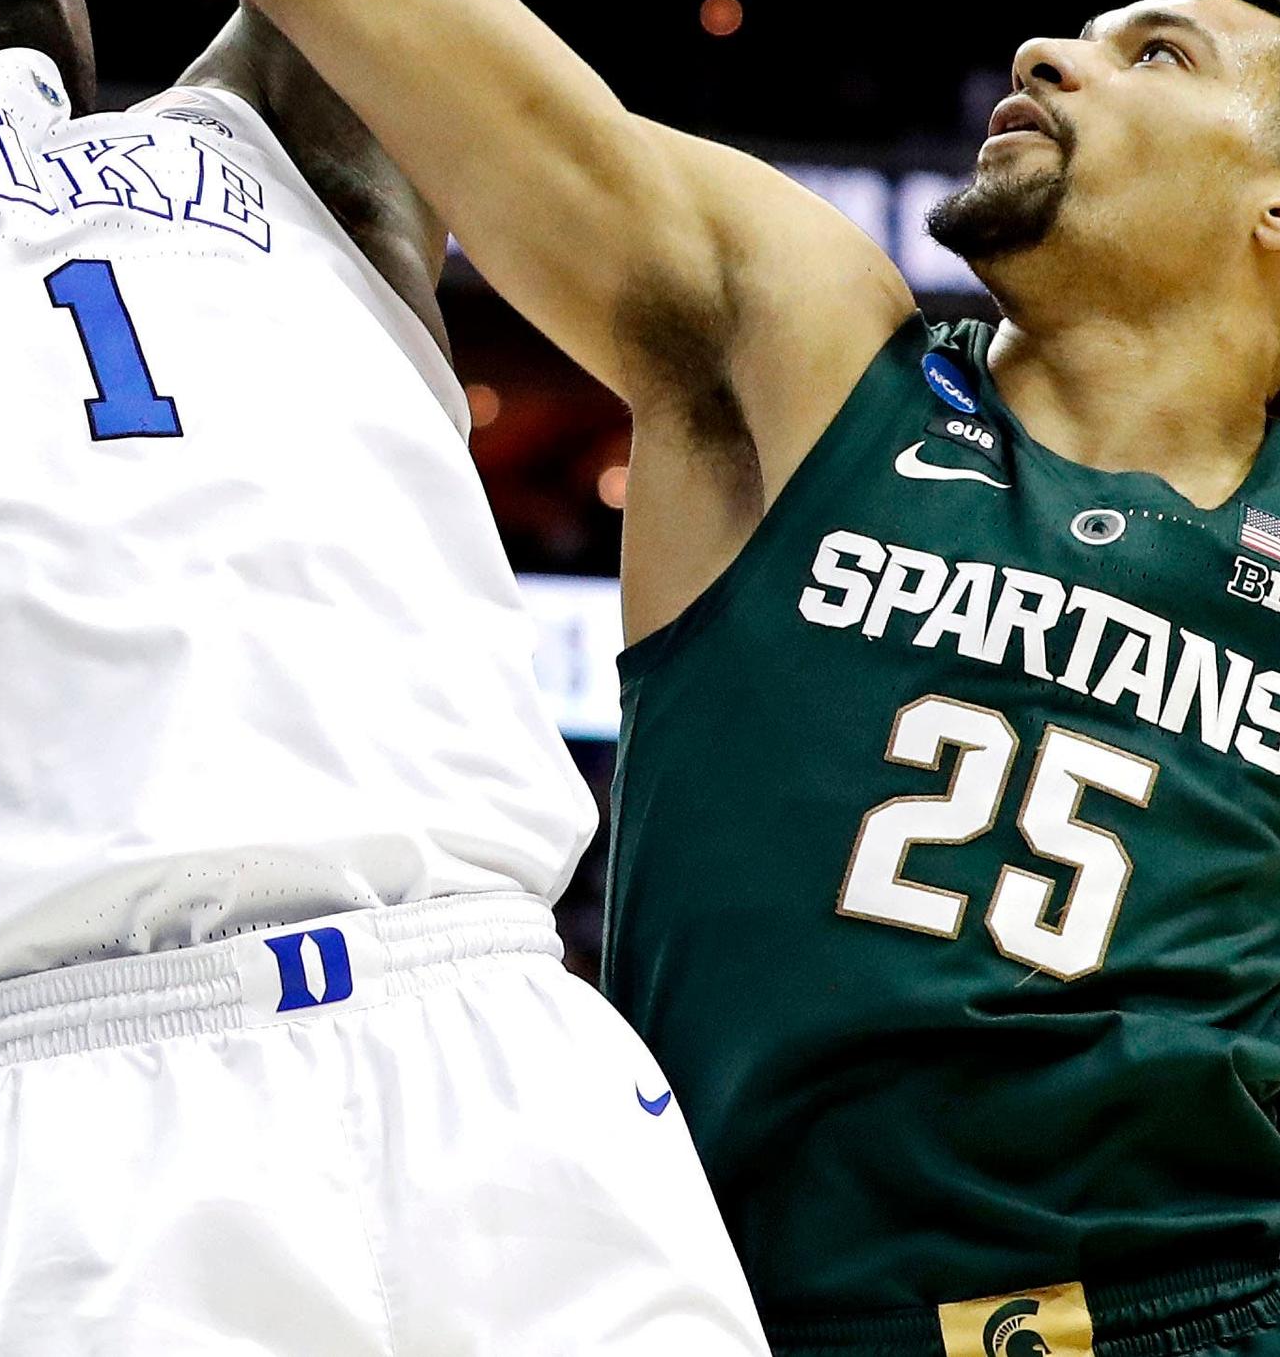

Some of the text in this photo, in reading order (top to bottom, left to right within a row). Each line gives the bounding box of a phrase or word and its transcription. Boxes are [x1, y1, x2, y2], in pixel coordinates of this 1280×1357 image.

[43, 258, 184, 441] 1
[928, 367, 974, 409] NCAA
[946, 420, 994, 449] GUS
[835, 694, 1160, 983] 25
[263, 927, 354, 1013] D
